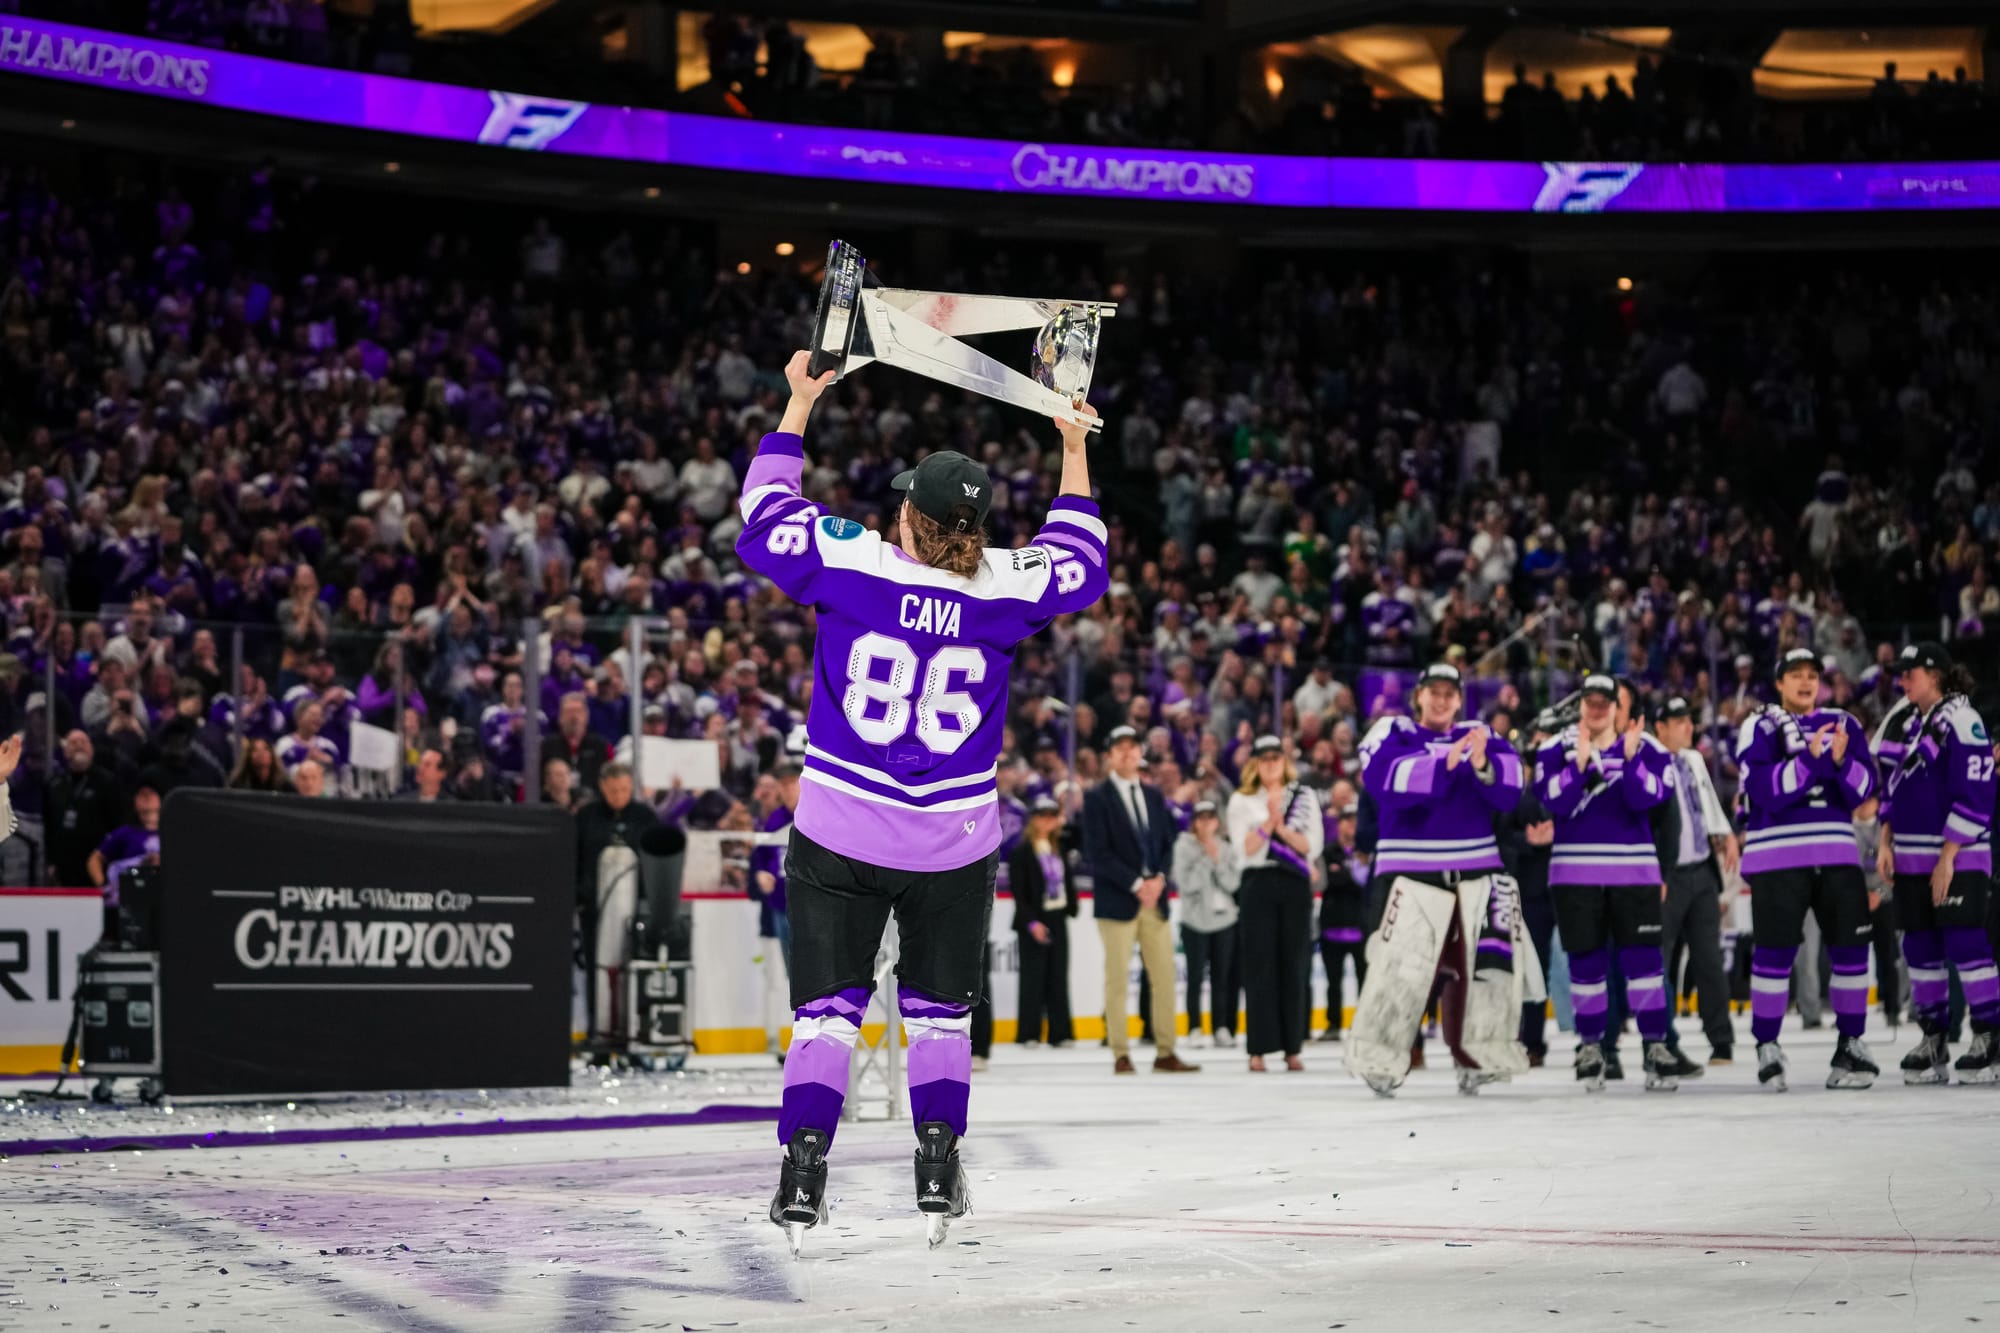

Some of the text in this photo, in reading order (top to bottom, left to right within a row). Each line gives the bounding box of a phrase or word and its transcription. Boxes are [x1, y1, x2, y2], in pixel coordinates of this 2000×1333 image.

[1012, 143, 1254, 198] CHAMPIONS
[899, 593, 961, 638] CAVA
[842, 630, 987, 755] 86
[1967, 754, 1995, 782] 27
[279, 886, 473, 912] PWHL WALTER CUP
[234, 908, 515, 969] CHAMPIONS
